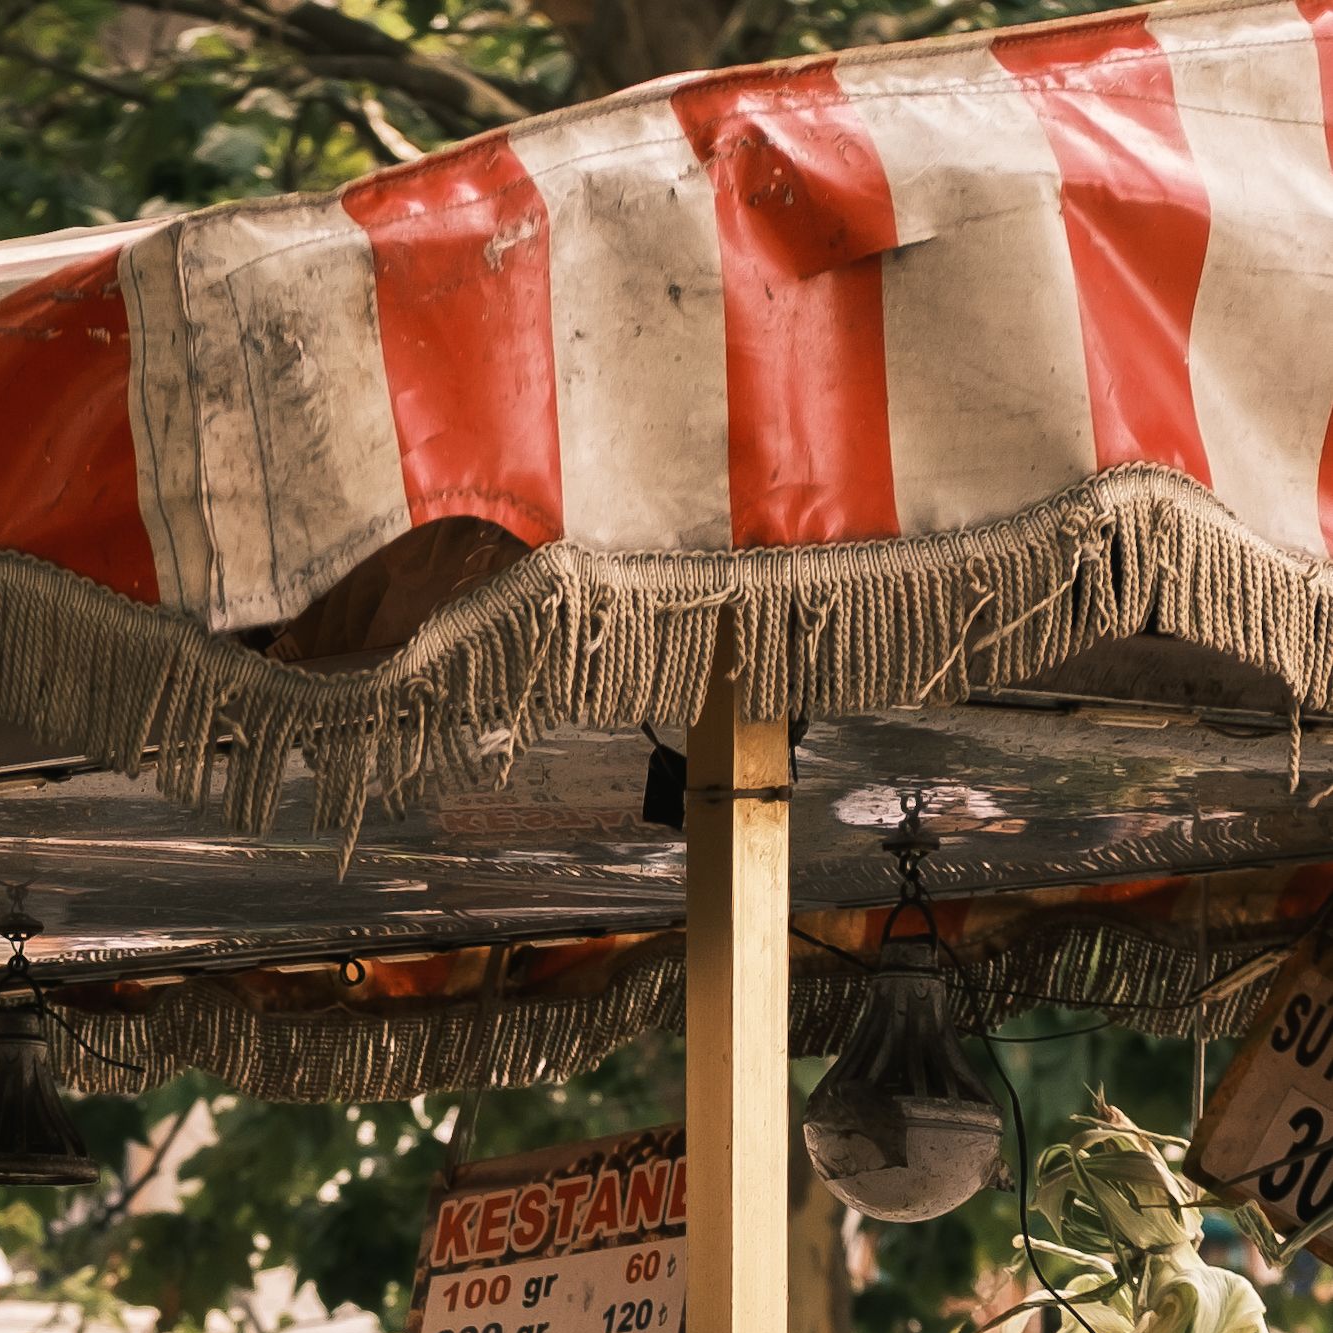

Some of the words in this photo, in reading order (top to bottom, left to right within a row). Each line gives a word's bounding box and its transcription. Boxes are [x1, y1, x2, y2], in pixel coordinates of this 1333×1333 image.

[1271, 993, 1333, 1081] SÜ
[443, 1273, 512, 1313] 100
[522, 1272, 559, 1309] gr
[625, 1249, 661, 1285] 60
